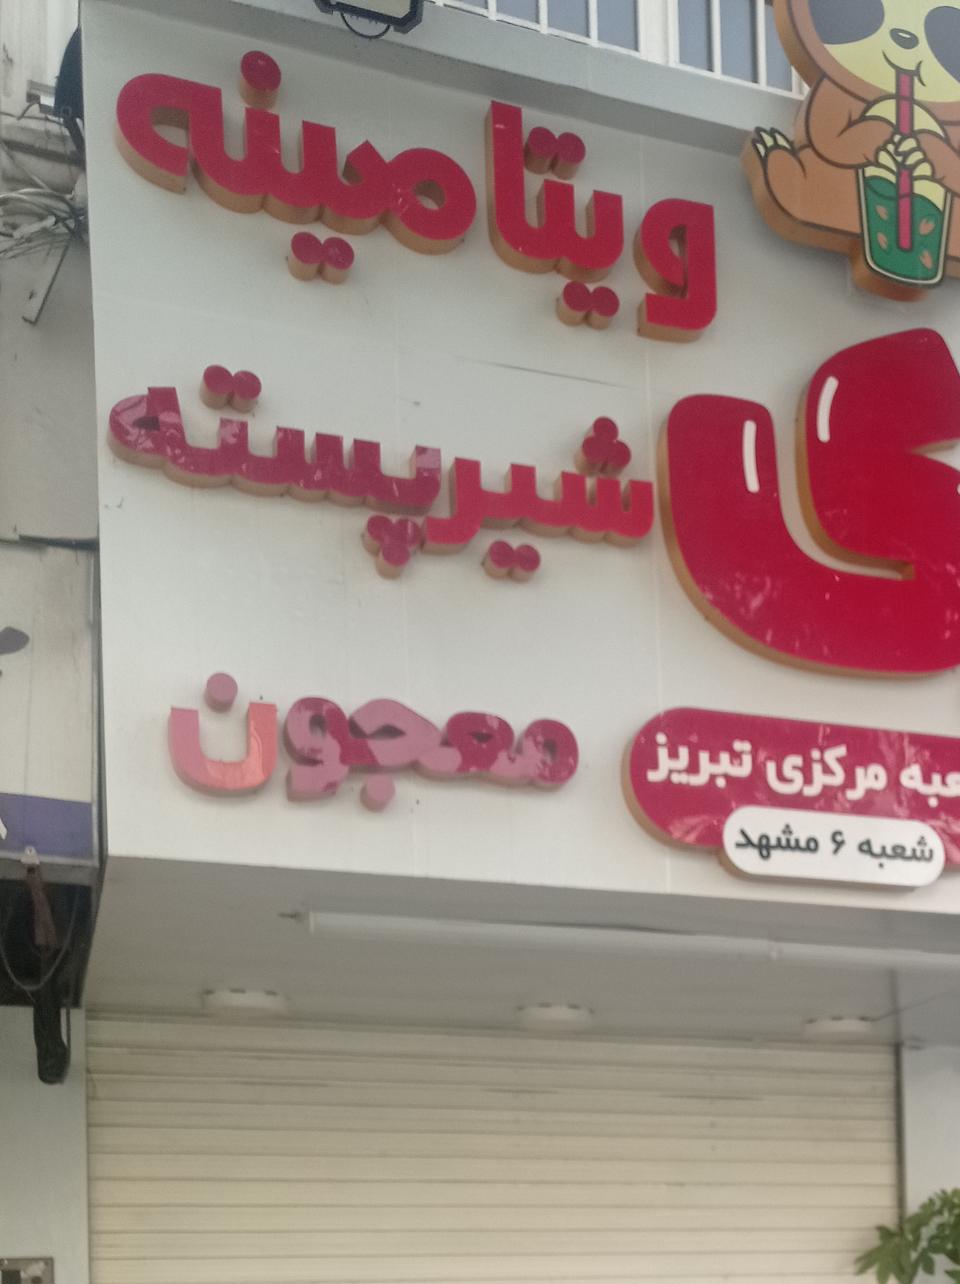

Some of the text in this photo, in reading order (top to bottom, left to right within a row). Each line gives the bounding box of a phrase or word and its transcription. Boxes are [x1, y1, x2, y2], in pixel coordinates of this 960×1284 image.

[117, 50, 717, 338] ویتامینه
[168, 673, 579, 808] معجون
[646, 732, 753, 788] تبریز
[765, 745, 888, 801] مرکزی
[734, 824, 820, 861] مشهد
[857, 836, 934, 868] شعبه
